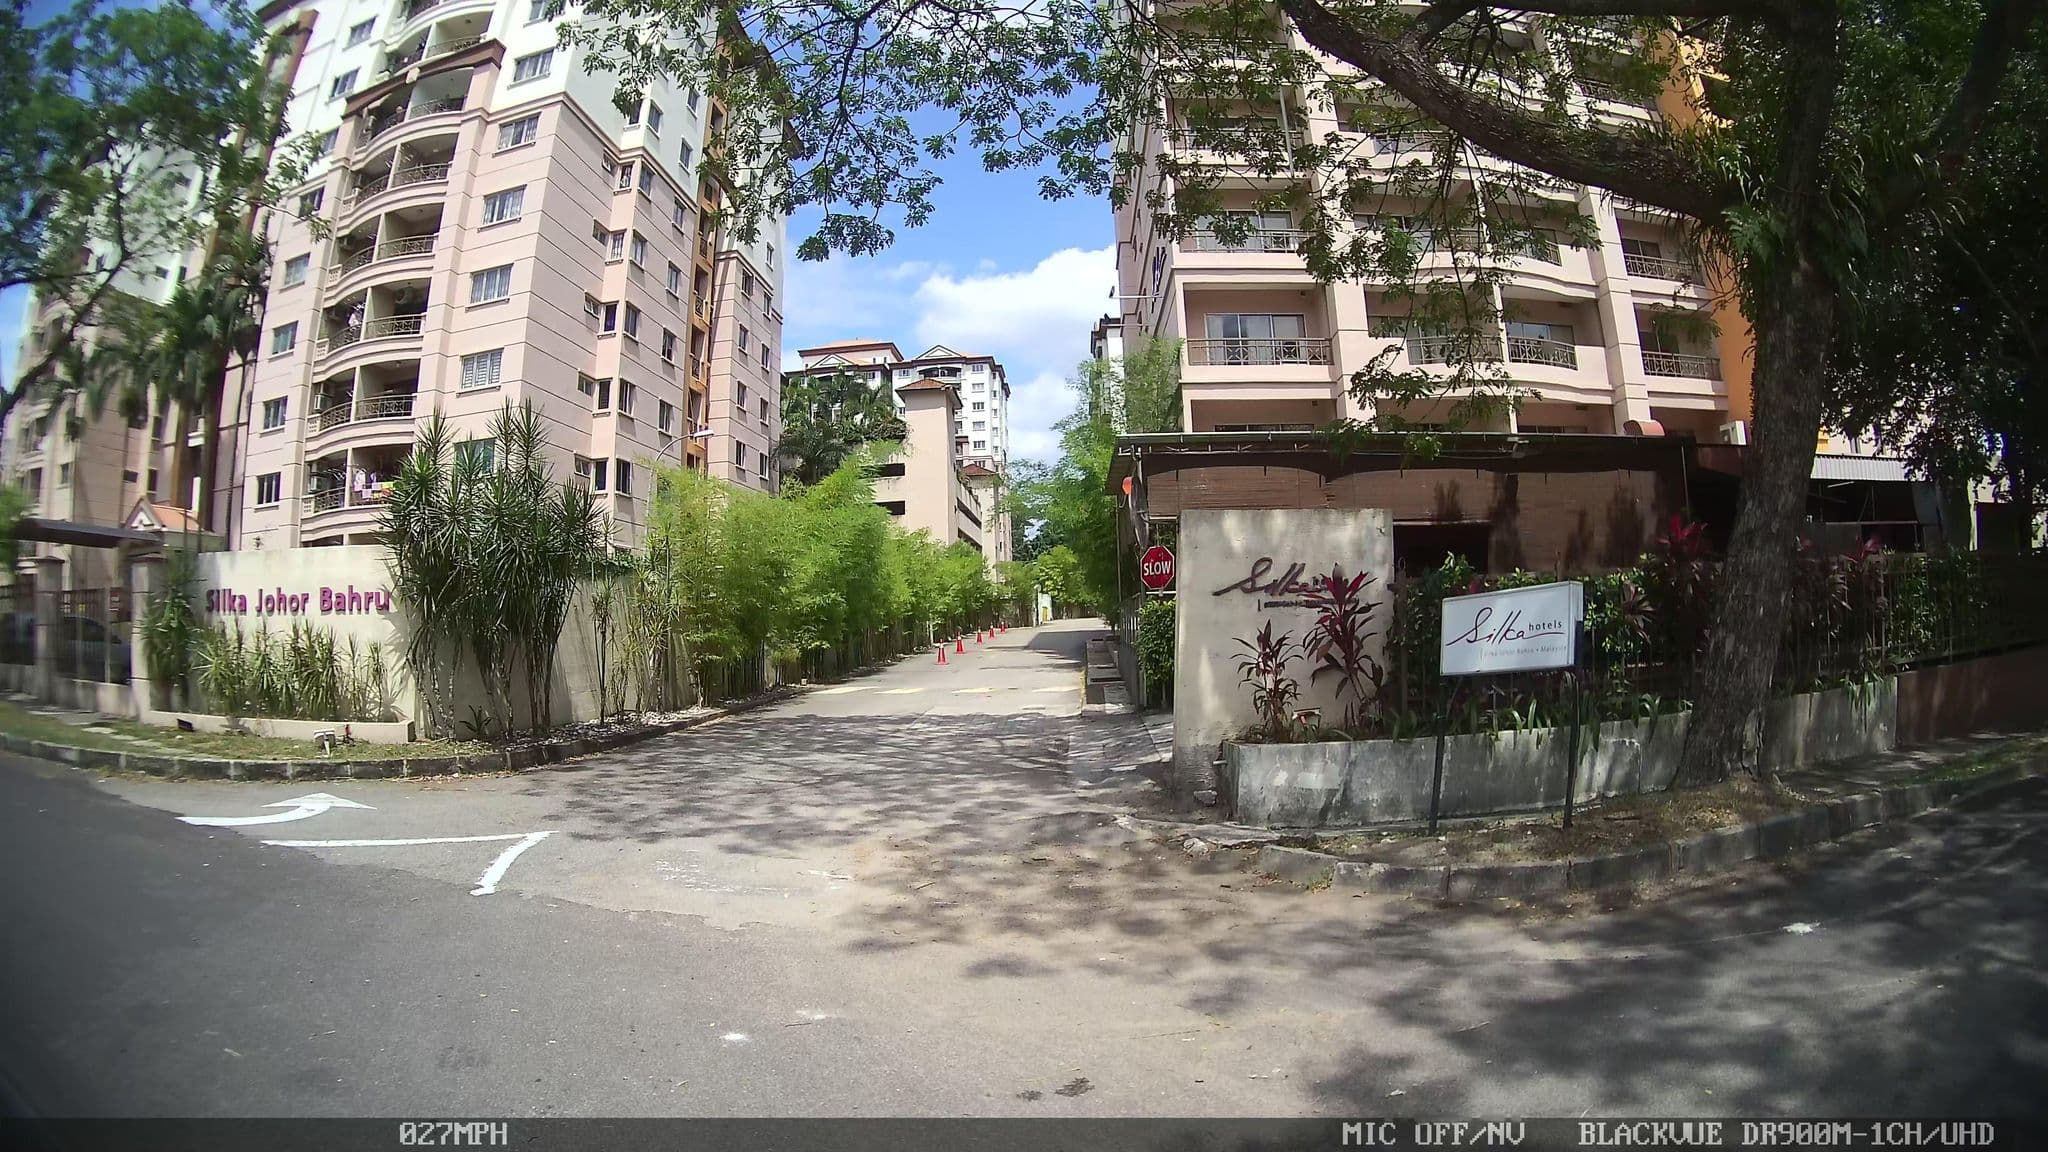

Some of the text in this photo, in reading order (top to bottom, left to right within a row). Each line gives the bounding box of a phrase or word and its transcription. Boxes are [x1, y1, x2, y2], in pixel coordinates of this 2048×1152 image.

[1143, 561, 1171, 576] SLOW
[205, 584, 391, 614] Silka Johor Bahru
[1446, 606, 1564, 646] Silka hotels
